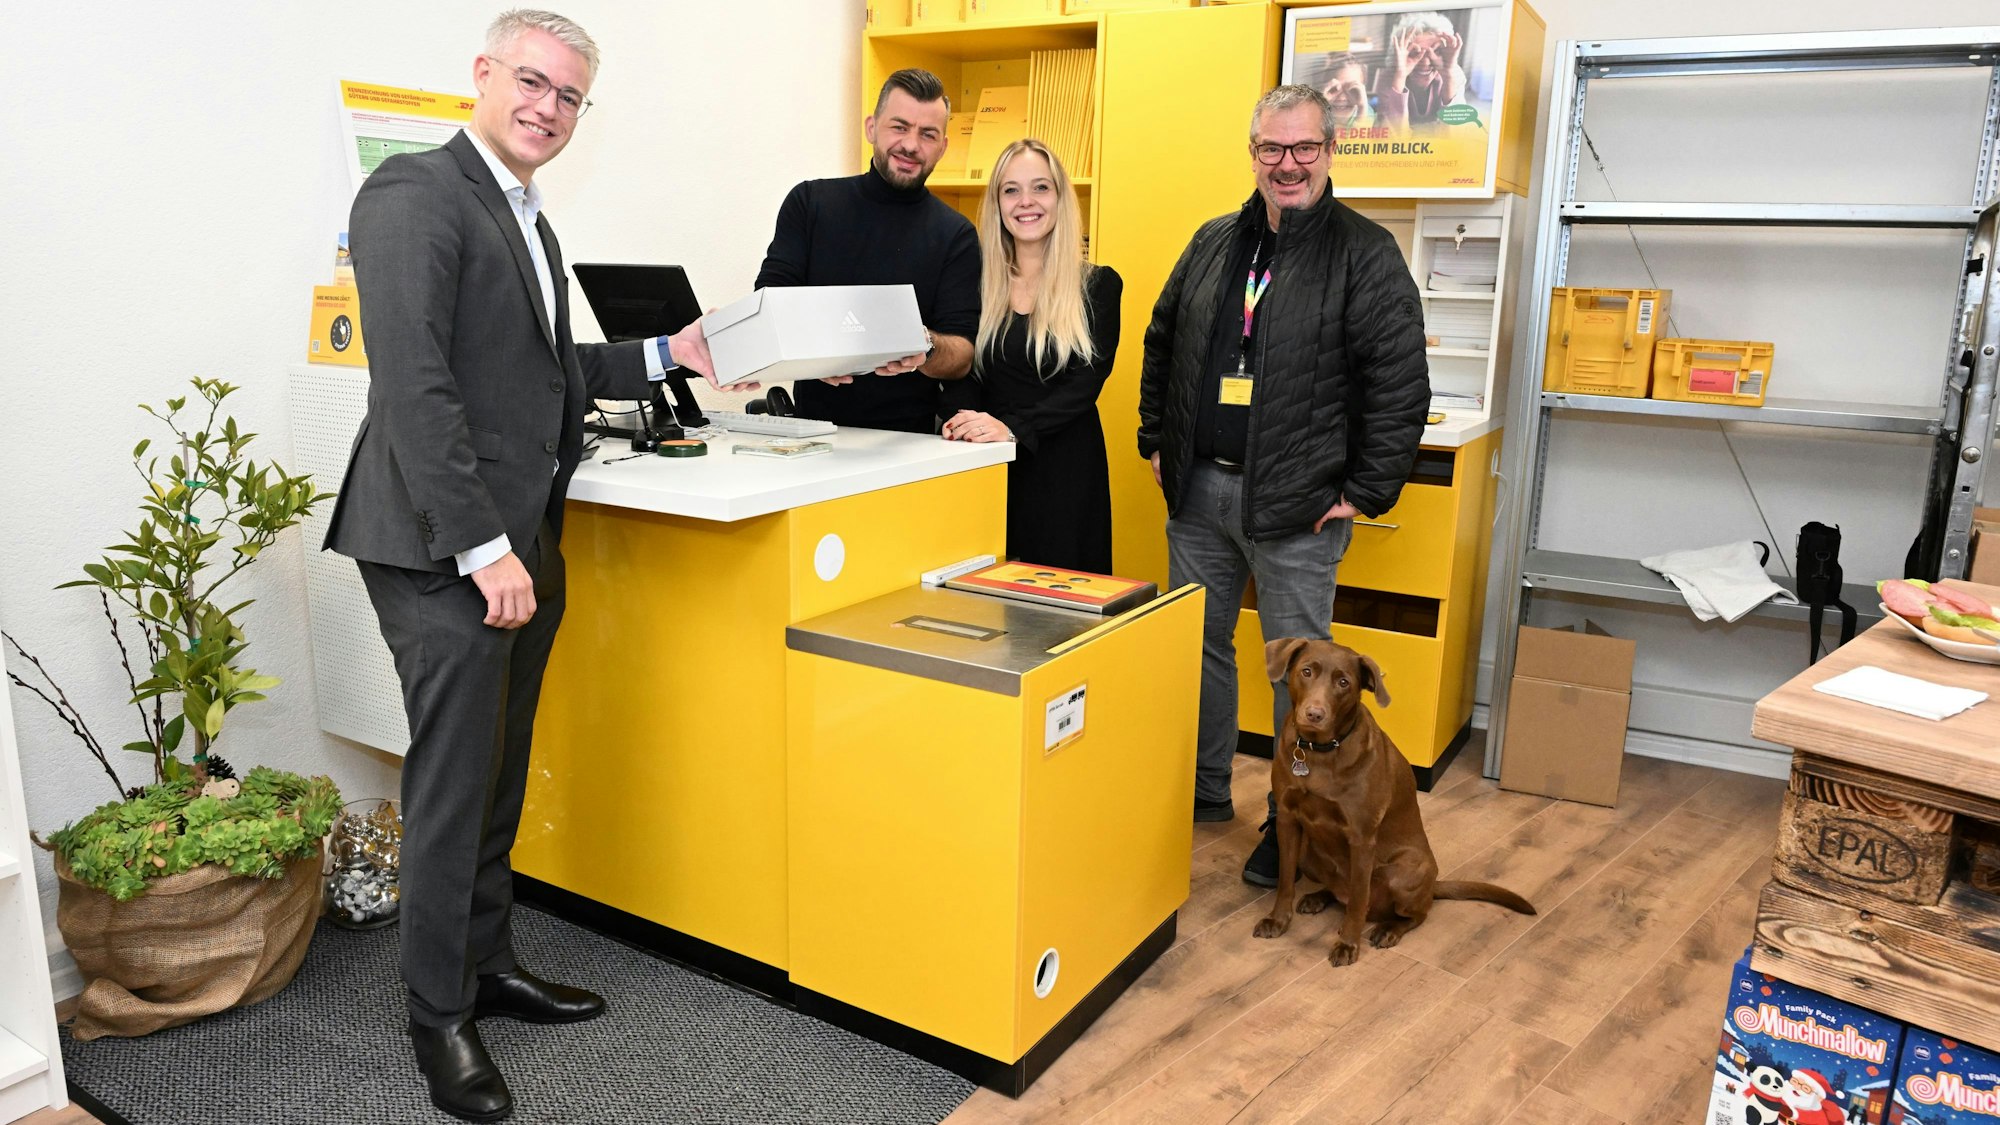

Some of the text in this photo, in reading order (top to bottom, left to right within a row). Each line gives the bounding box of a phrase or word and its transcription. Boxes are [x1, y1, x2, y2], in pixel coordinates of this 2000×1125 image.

[390, 91, 401, 99] VON
[1350, 127, 1389, 139] DEINE
[1373, 143, 1389, 155] IM
[1391, 142, 1434, 155] BLICK.
[1818, 826, 1897, 877] EPAL
[1785, 1004, 1837, 1024] Family Pack
[1735, 1003, 1887, 1063] Munchmallow
